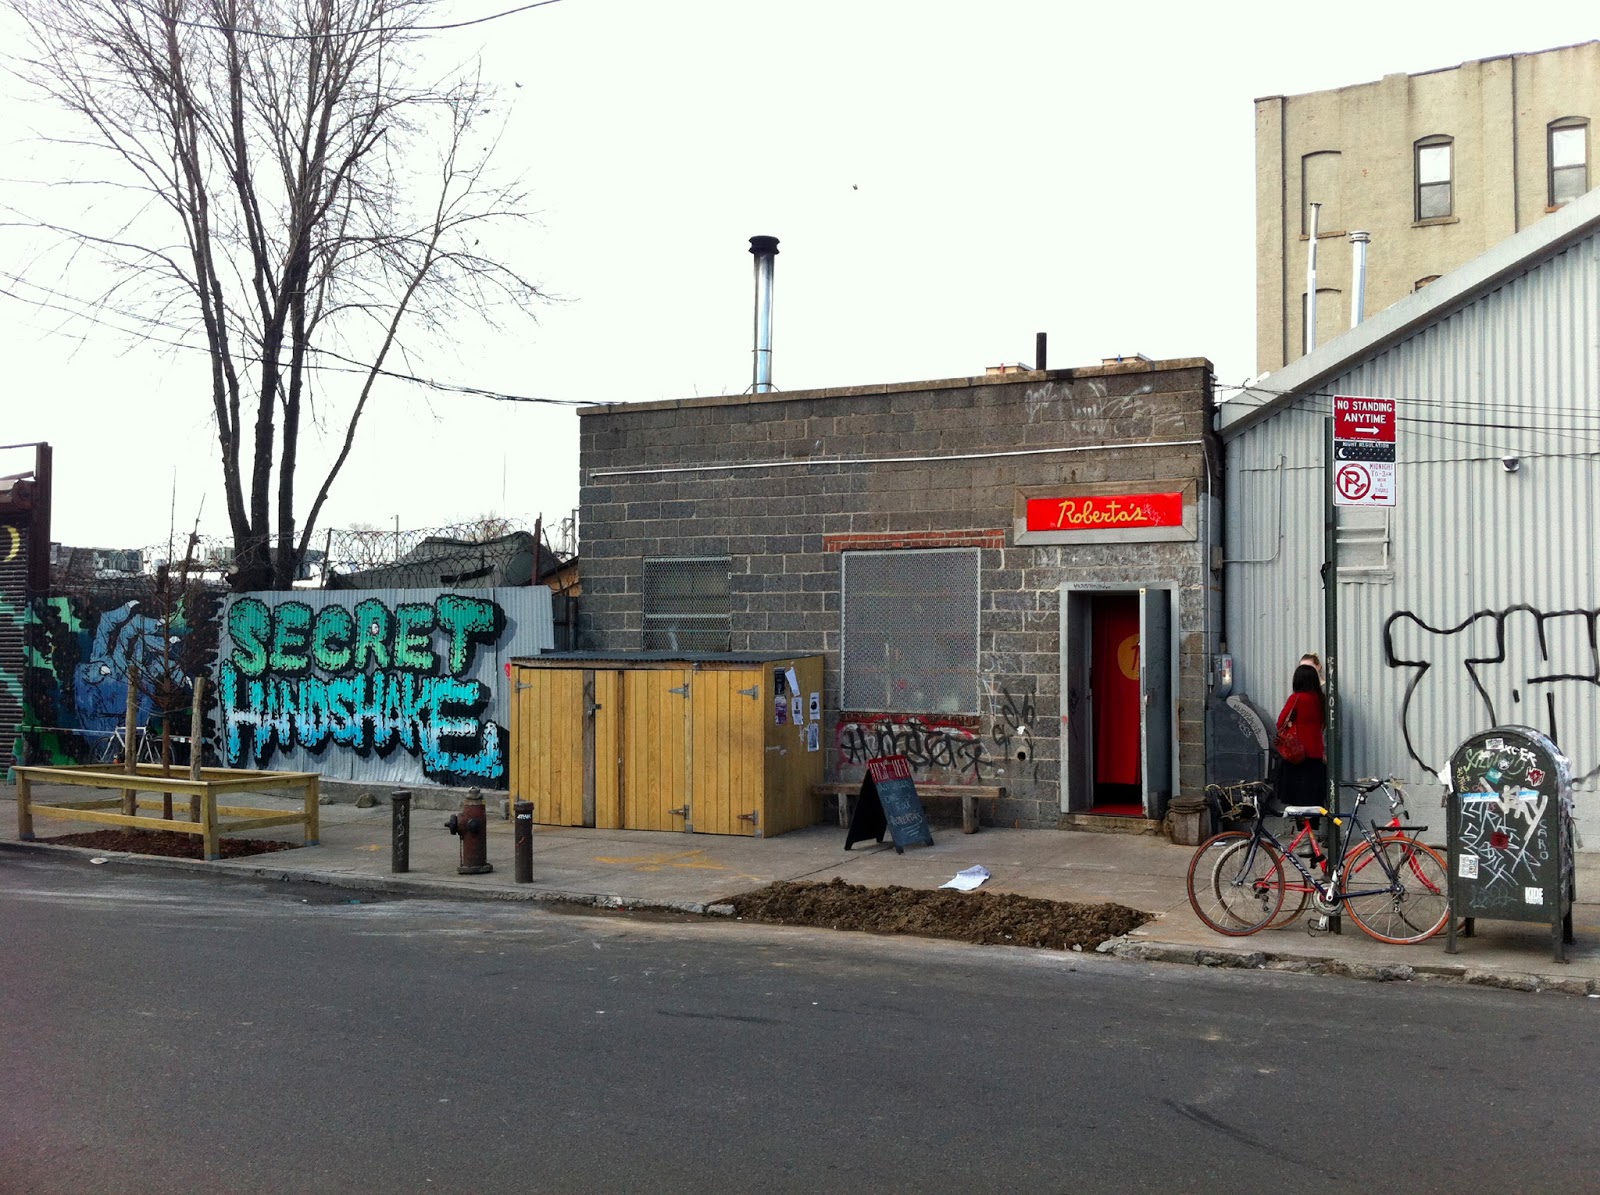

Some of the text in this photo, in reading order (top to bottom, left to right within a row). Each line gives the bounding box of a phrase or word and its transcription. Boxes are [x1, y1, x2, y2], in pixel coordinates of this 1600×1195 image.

[1337, 400, 1392, 412] NO STANDING
[1344, 413, 1386, 424] ANYTIME
[1056, 500, 1148, 528] Roberta's
[228, 593, 502, 678] SECRET
[219, 659, 505, 782] HANDSHAKE
